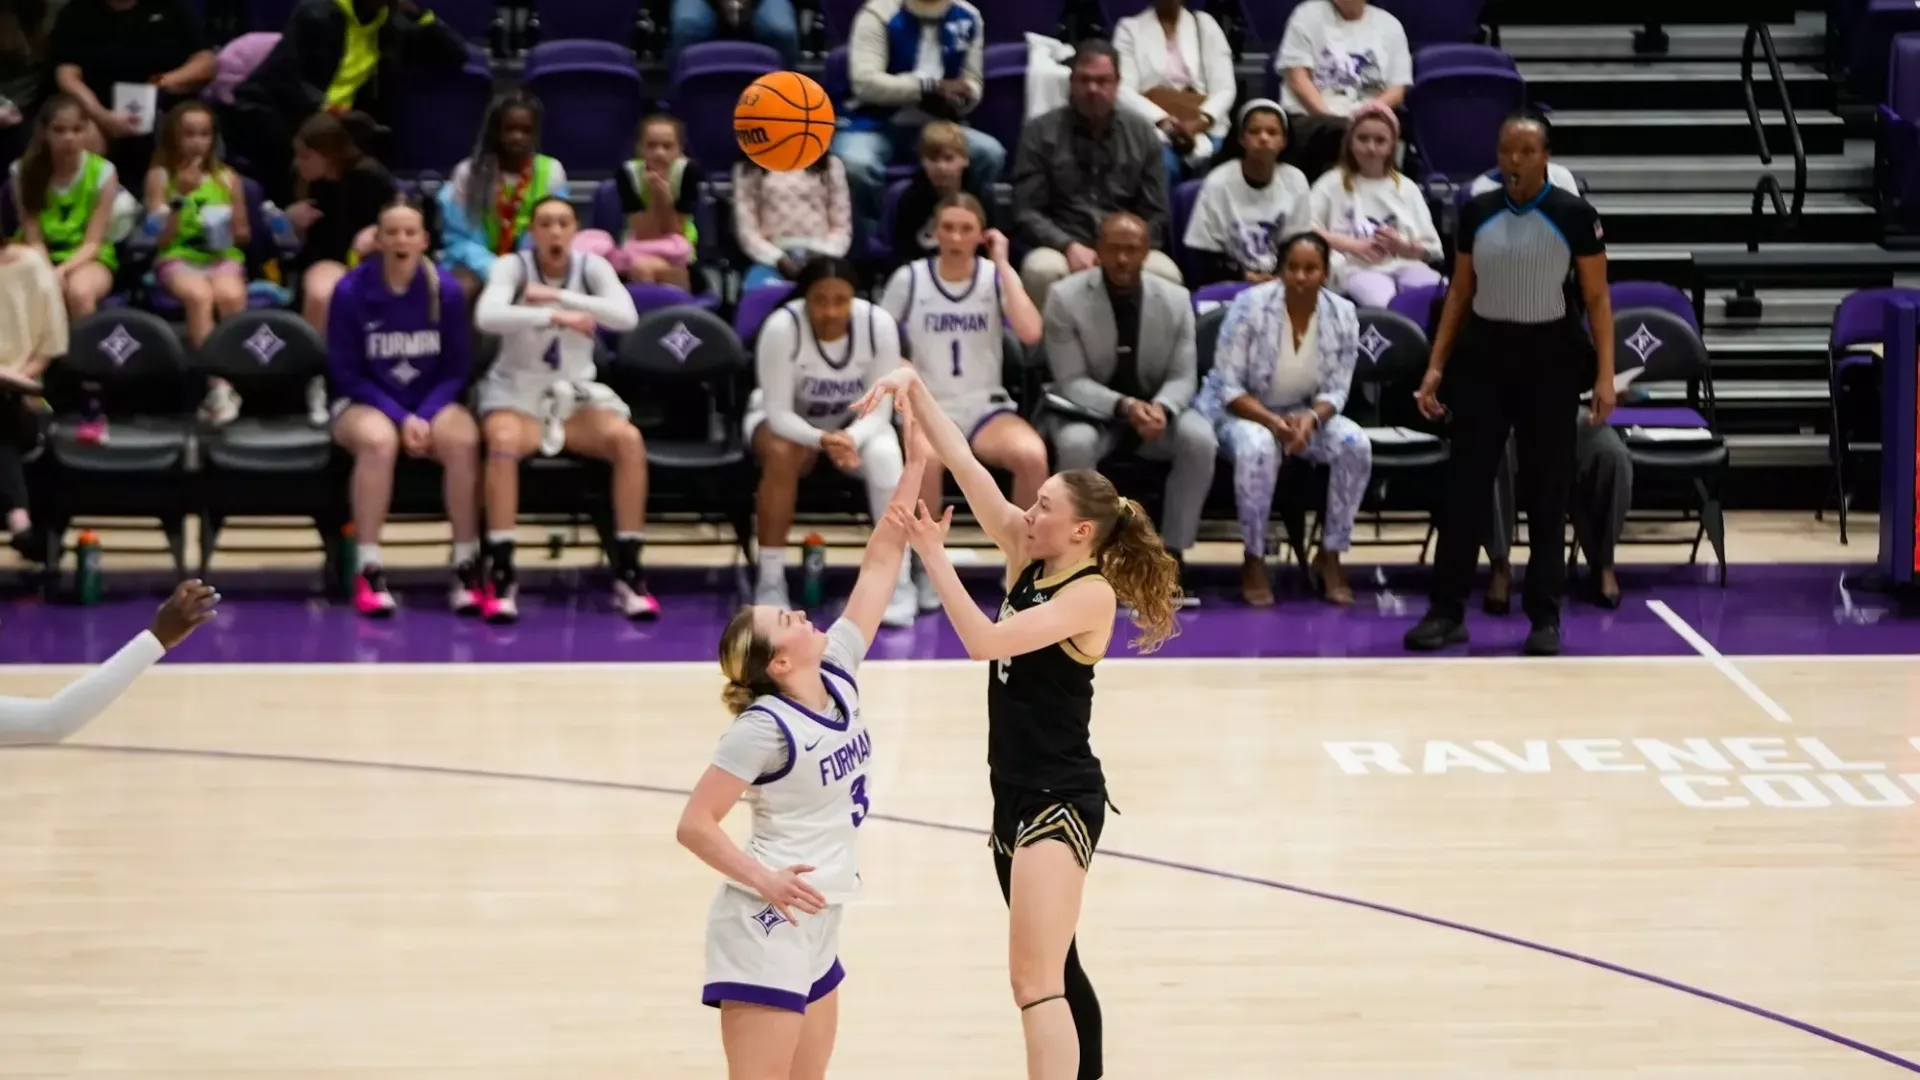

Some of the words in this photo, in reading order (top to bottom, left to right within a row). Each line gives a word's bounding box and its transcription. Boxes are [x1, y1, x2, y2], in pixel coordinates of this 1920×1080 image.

[924, 312, 989, 334] FURMAN
[366, 330, 441, 359] FURMAN
[541, 336, 561, 371] 4
[950, 339, 963, 378] 1
[1321, 736, 1886, 774] RAVENEL
[850, 773, 870, 829] 3
